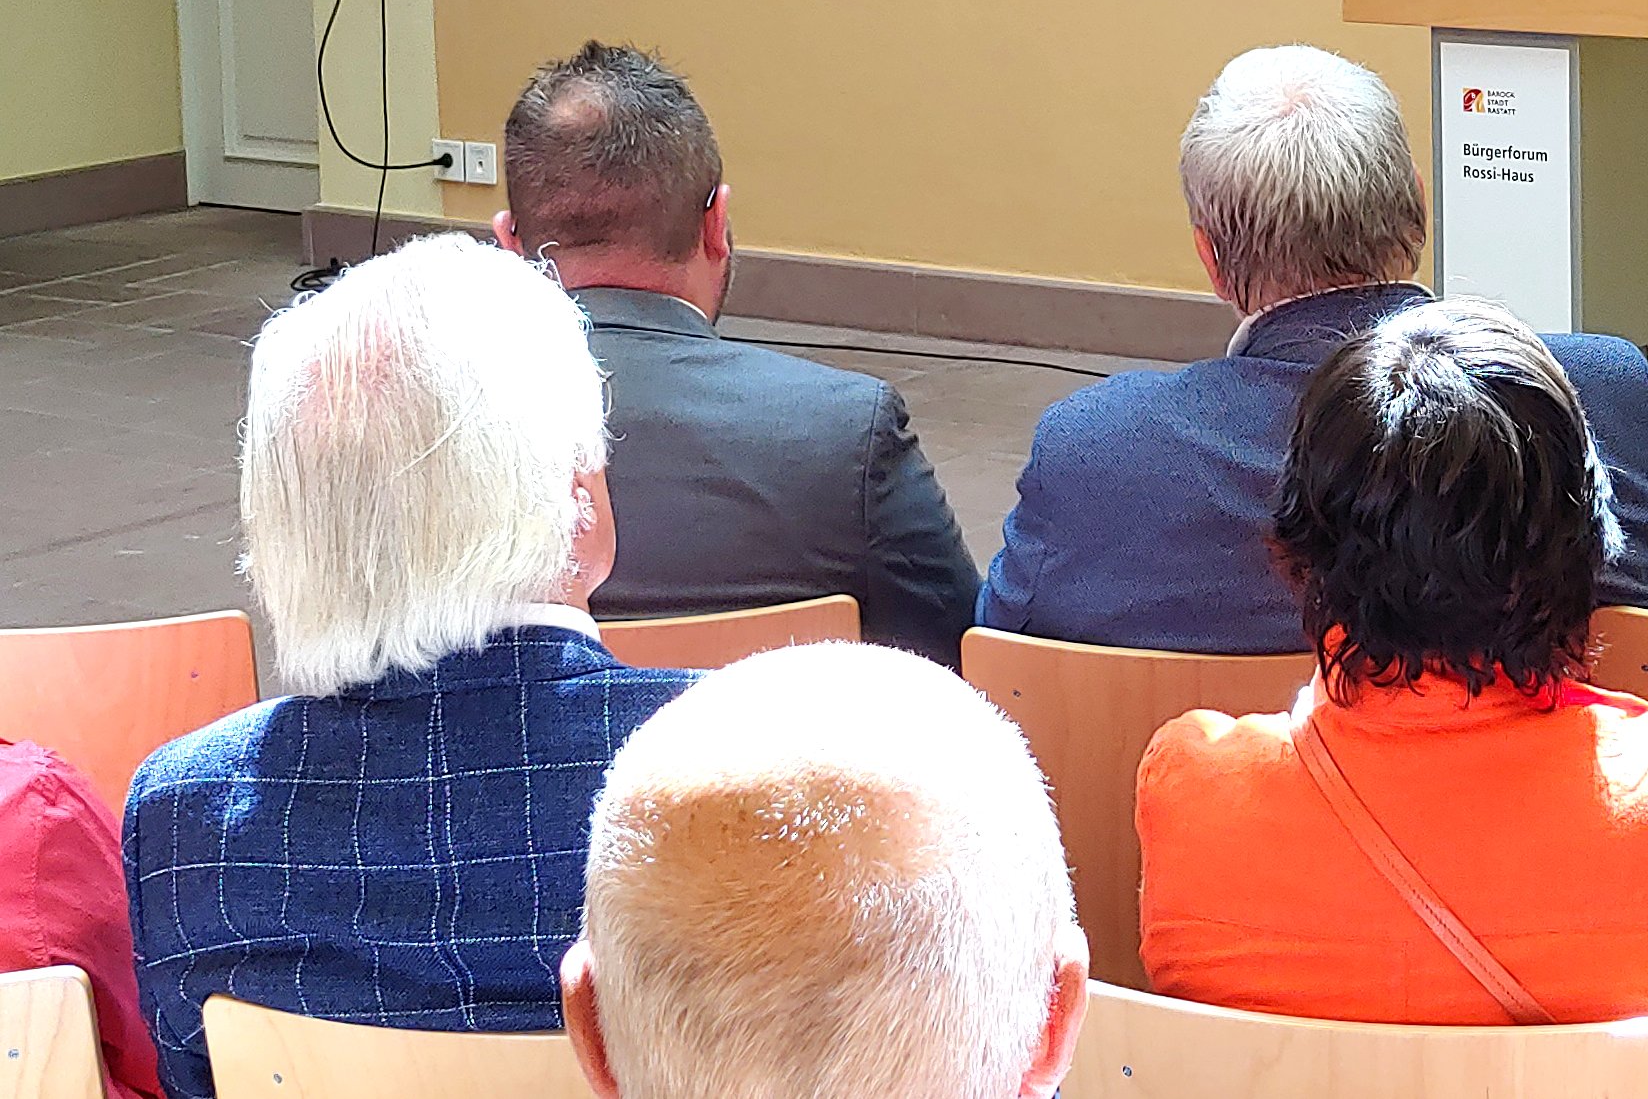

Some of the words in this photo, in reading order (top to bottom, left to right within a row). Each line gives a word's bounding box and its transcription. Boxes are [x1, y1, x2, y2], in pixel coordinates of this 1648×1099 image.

[1487, 99, 1509, 107] STADT
[1487, 107, 1516, 116] RASTATT
[1462, 143, 1548, 162] Bürgerforum
[1462, 165, 1534, 183] Rossi-Haus
